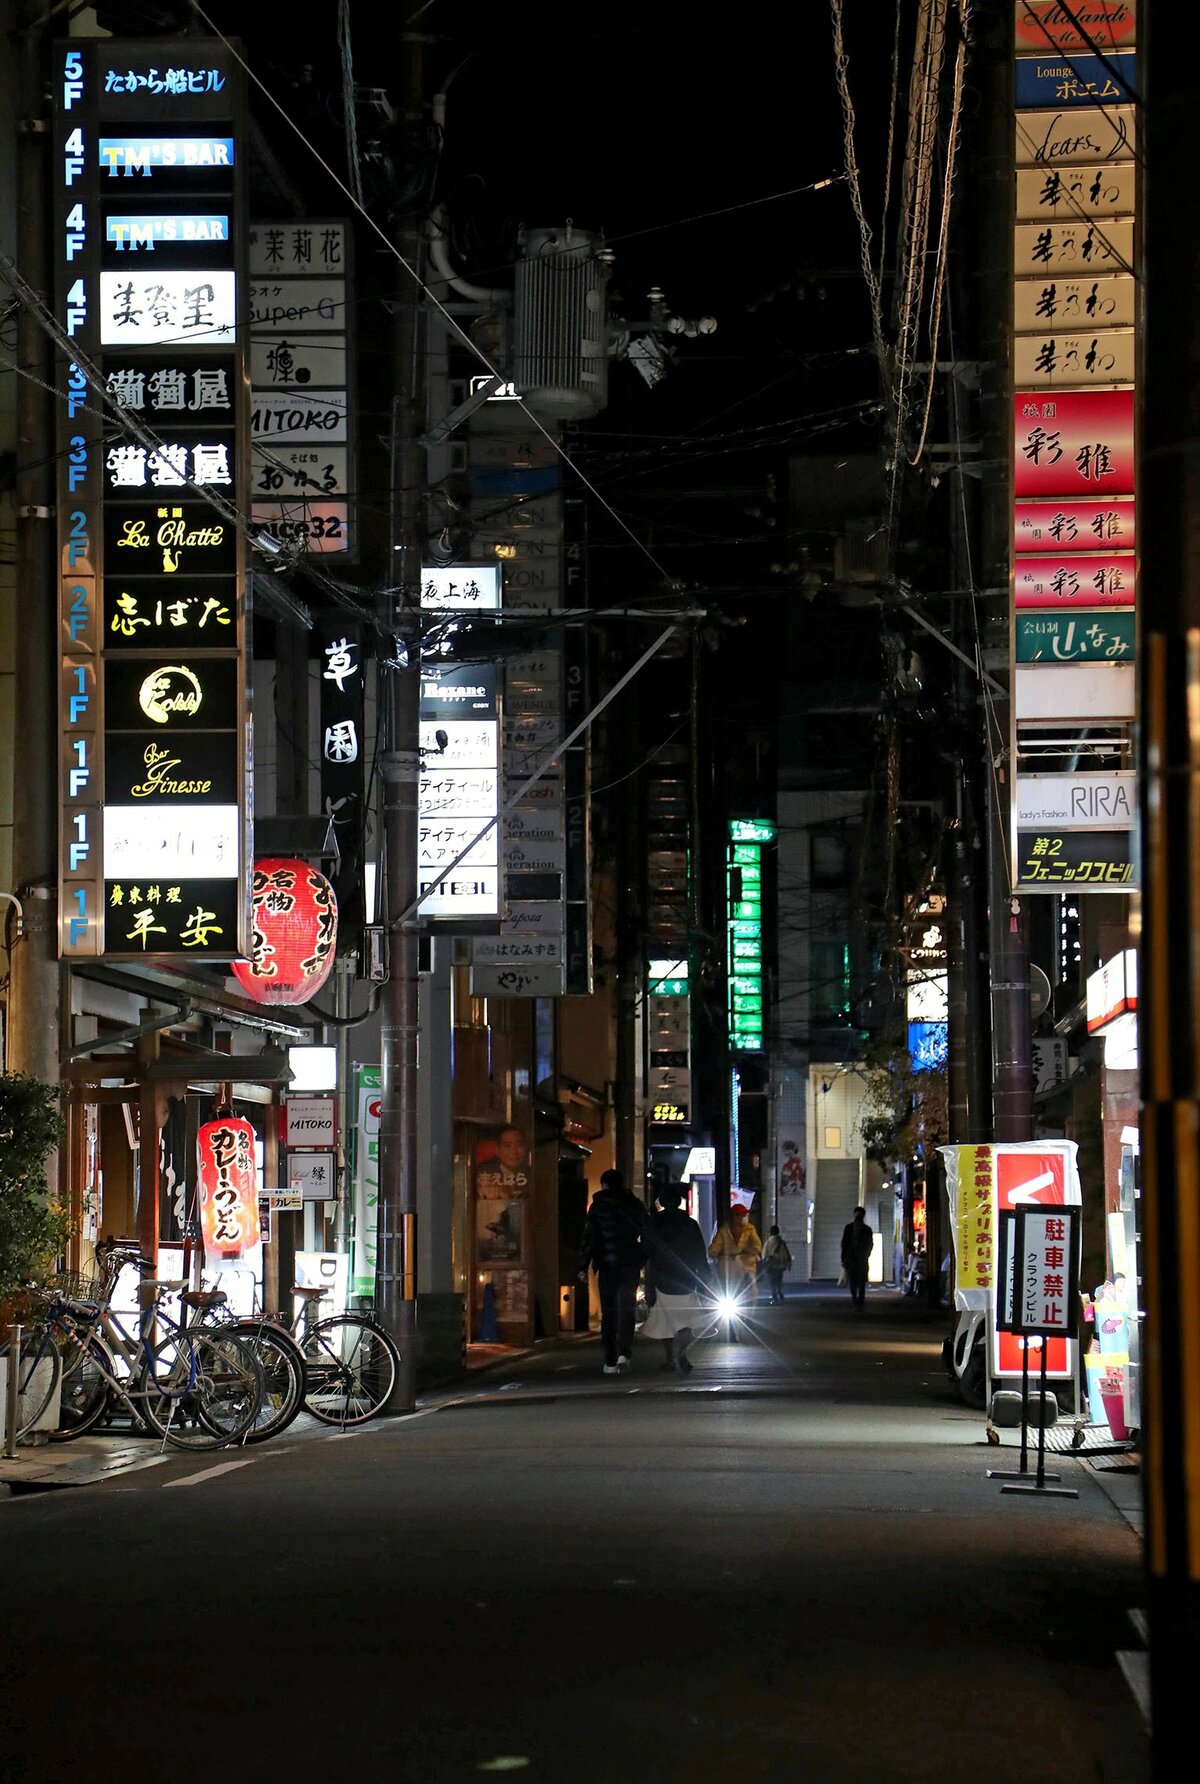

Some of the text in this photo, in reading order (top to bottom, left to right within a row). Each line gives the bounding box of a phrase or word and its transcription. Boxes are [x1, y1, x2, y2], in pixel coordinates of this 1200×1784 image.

[64, 52, 83, 110] 5F
[104, 69, 226, 94] たから船ビル
[1036, 66, 1074, 78] Lounge
[1056, 79, 1120, 100] ポエム
[65, 128, 84, 186] 4F
[103, 144, 231, 177] TM'S BAR
[66, 204, 85, 261] 4F
[111, 220, 177, 250] TM'S
[182, 220, 225, 240] BAR
[263, 229, 342, 264] 茉莉花
[67, 279, 86, 337] 4F
[106, 368, 232, 411] 葡萄屋
[68, 435, 88, 492] 3F
[106, 443, 232, 488] 葡萄屋
[290, 454, 319, 464] そば処
[1022, 427, 1116, 480] 彩雅
[69, 511, 88, 567] 2F
[117, 521, 224, 547] La Chatte
[1048, 512, 1125, 542] 彩雅
[422, 579, 481, 602] 夜上海
[1049, 567, 1126, 597] 彩雅
[69, 585, 88, 641] 2F
[70, 666, 89, 724] 1F
[70, 740, 89, 797] 1F
[143, 743, 170, 767] Bar
[131, 759, 212, 797] Finesse
[1020, 786, 1131, 820] Lady's Fashion RIRA
[70, 814, 89, 871] 1F
[1033, 837, 1063, 856] 第2
[1021, 860, 1136, 882] フェニックスビル
[70, 889, 89, 946] 1F
[126, 906, 224, 951] 平安
[495, 943, 558, 956] はなみずき
[290, 1119, 333, 1130] MITOKO
[211, 1128, 240, 1241] カレーうどん
[311, 1166, 327, 1181] 縁
[275, 1197, 301, 1207] カレー
[974, 1145, 993, 1288] 最高級サプリあります
[1024, 1252, 1038, 1324] クラウンビル
[1042, 1218, 1066, 1326] 駐車禁止
